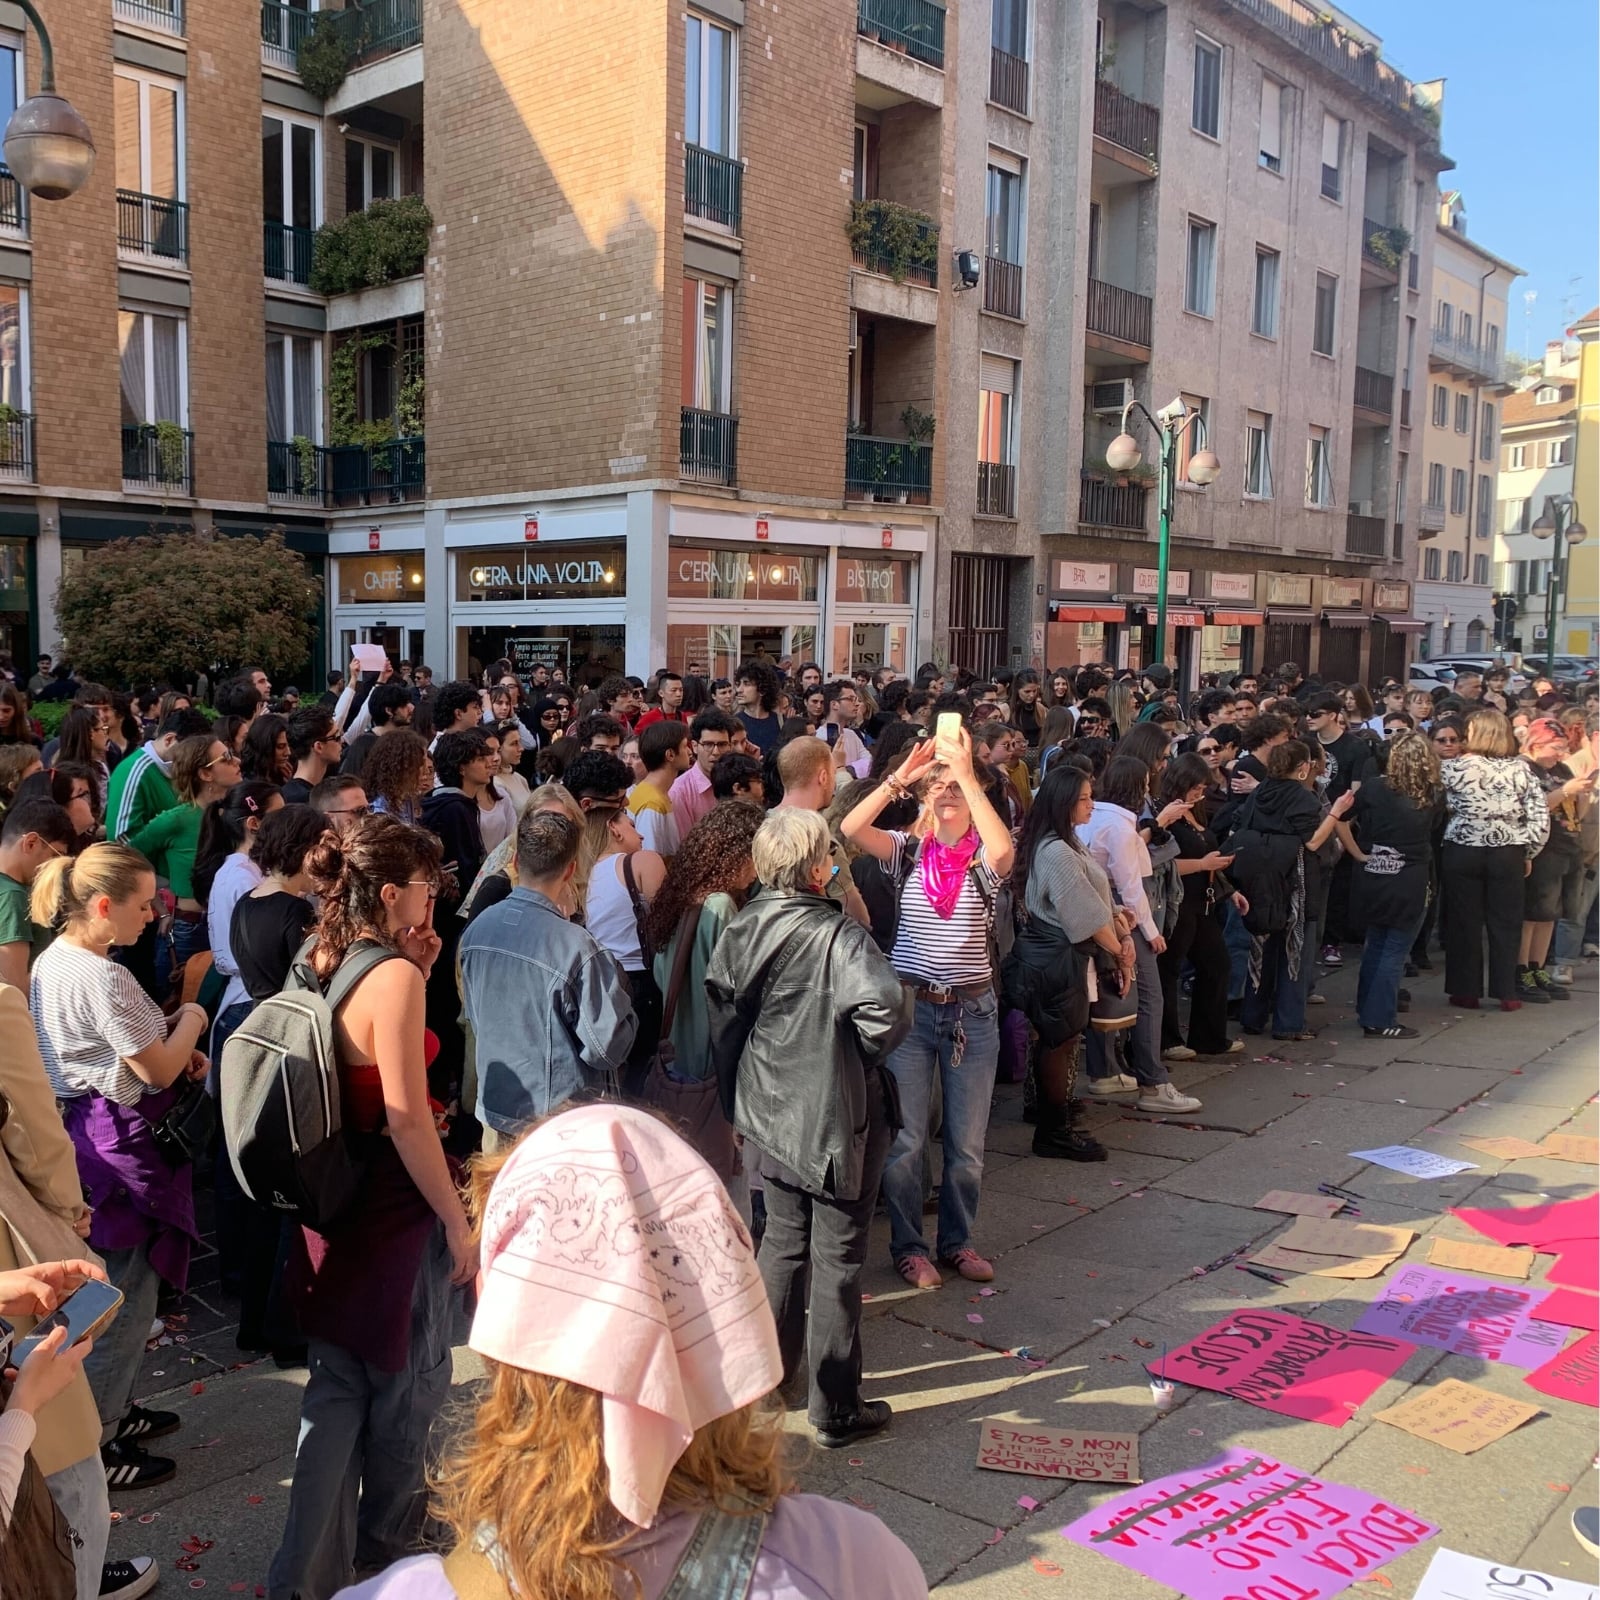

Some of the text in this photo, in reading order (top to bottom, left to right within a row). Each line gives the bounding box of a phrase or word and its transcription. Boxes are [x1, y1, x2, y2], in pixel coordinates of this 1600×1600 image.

[364, 565, 403, 590] CAFFÈ
[517, 563, 552, 584] UNA
[555, 560, 606, 583] VOLTA
[679, 560, 801, 586] C'ERA UNA VOLTA
[847, 569, 895, 589] BISTROT
[1175, 1315, 1288, 1375] UCCIDE
[1060, 1438, 1074, 1448] 6
[1083, 1438, 1131, 1450] NON
[982, 1456, 1128, 1480] E QUANDO
[1036, 1454, 1095, 1467] NOTTE
[1212, 1495, 1350, 1571] FIGLIO
[1302, 1502, 1431, 1577] EDUCA
